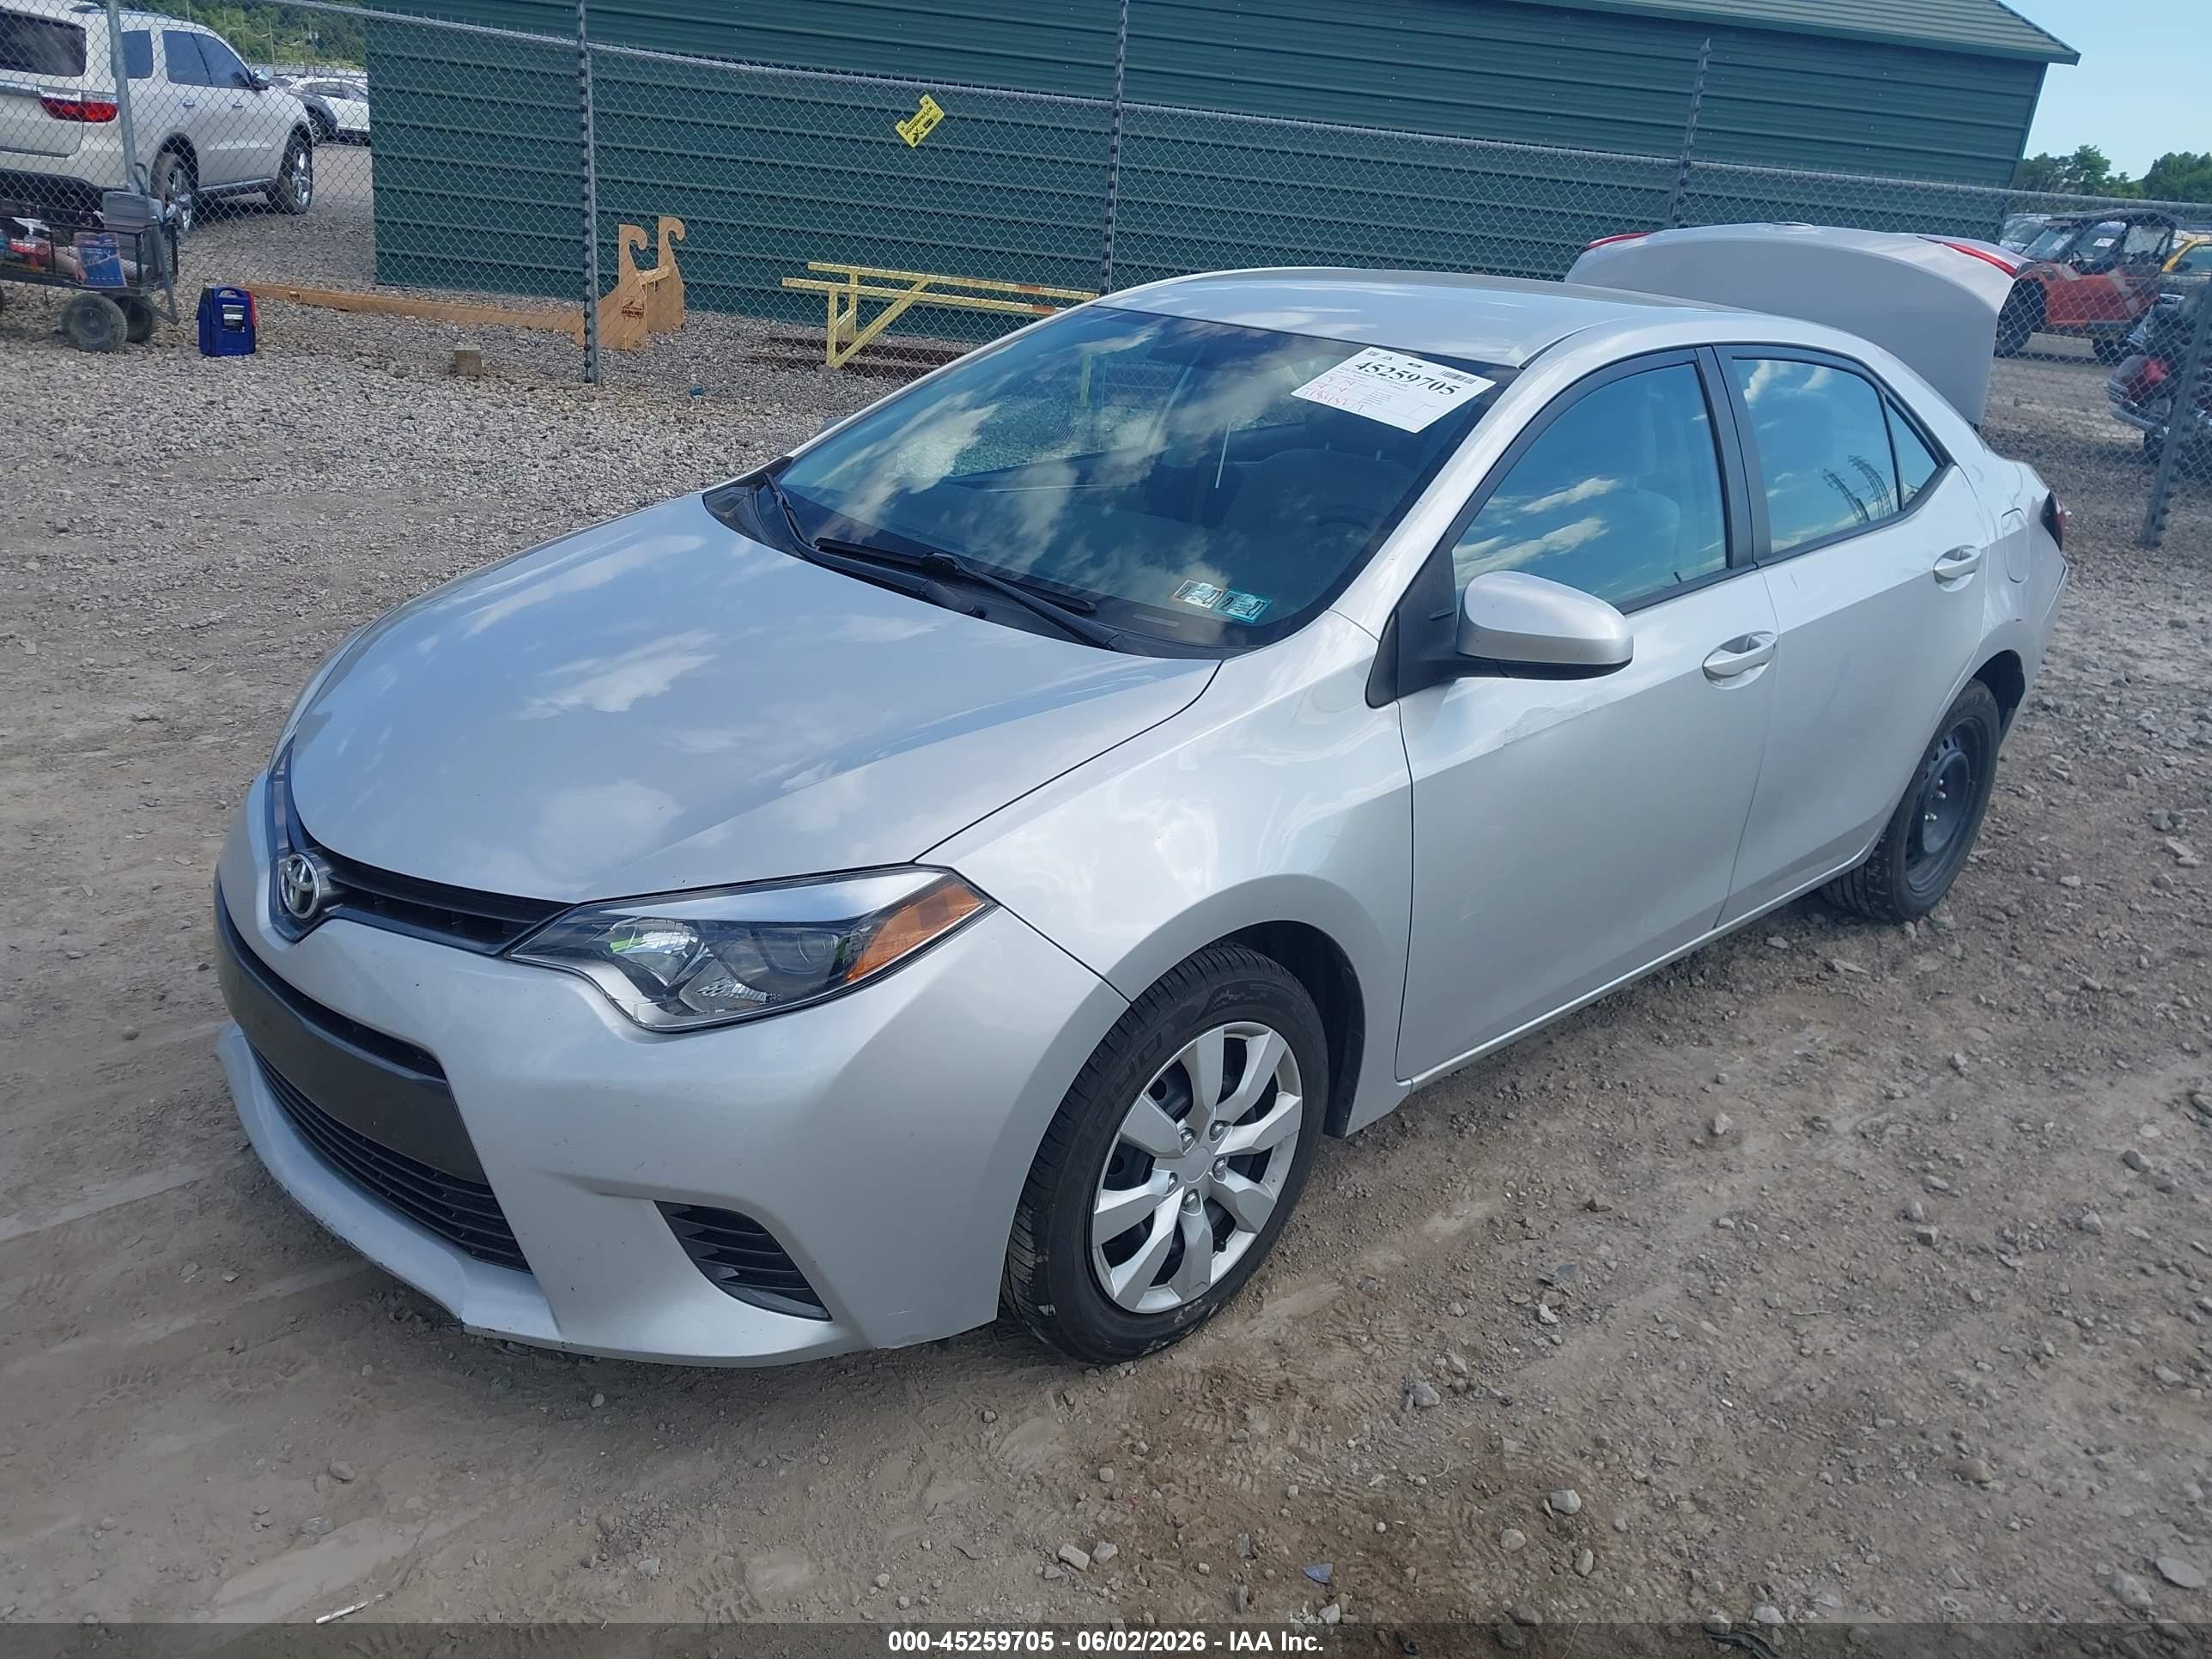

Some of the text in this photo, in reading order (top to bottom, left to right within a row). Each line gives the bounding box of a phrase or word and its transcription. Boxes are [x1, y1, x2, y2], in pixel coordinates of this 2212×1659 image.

[1353, 360, 1464, 395] 45259705
[1202, 589, 1222, 605] 27
[1220, 597, 1267, 618] 2 27
